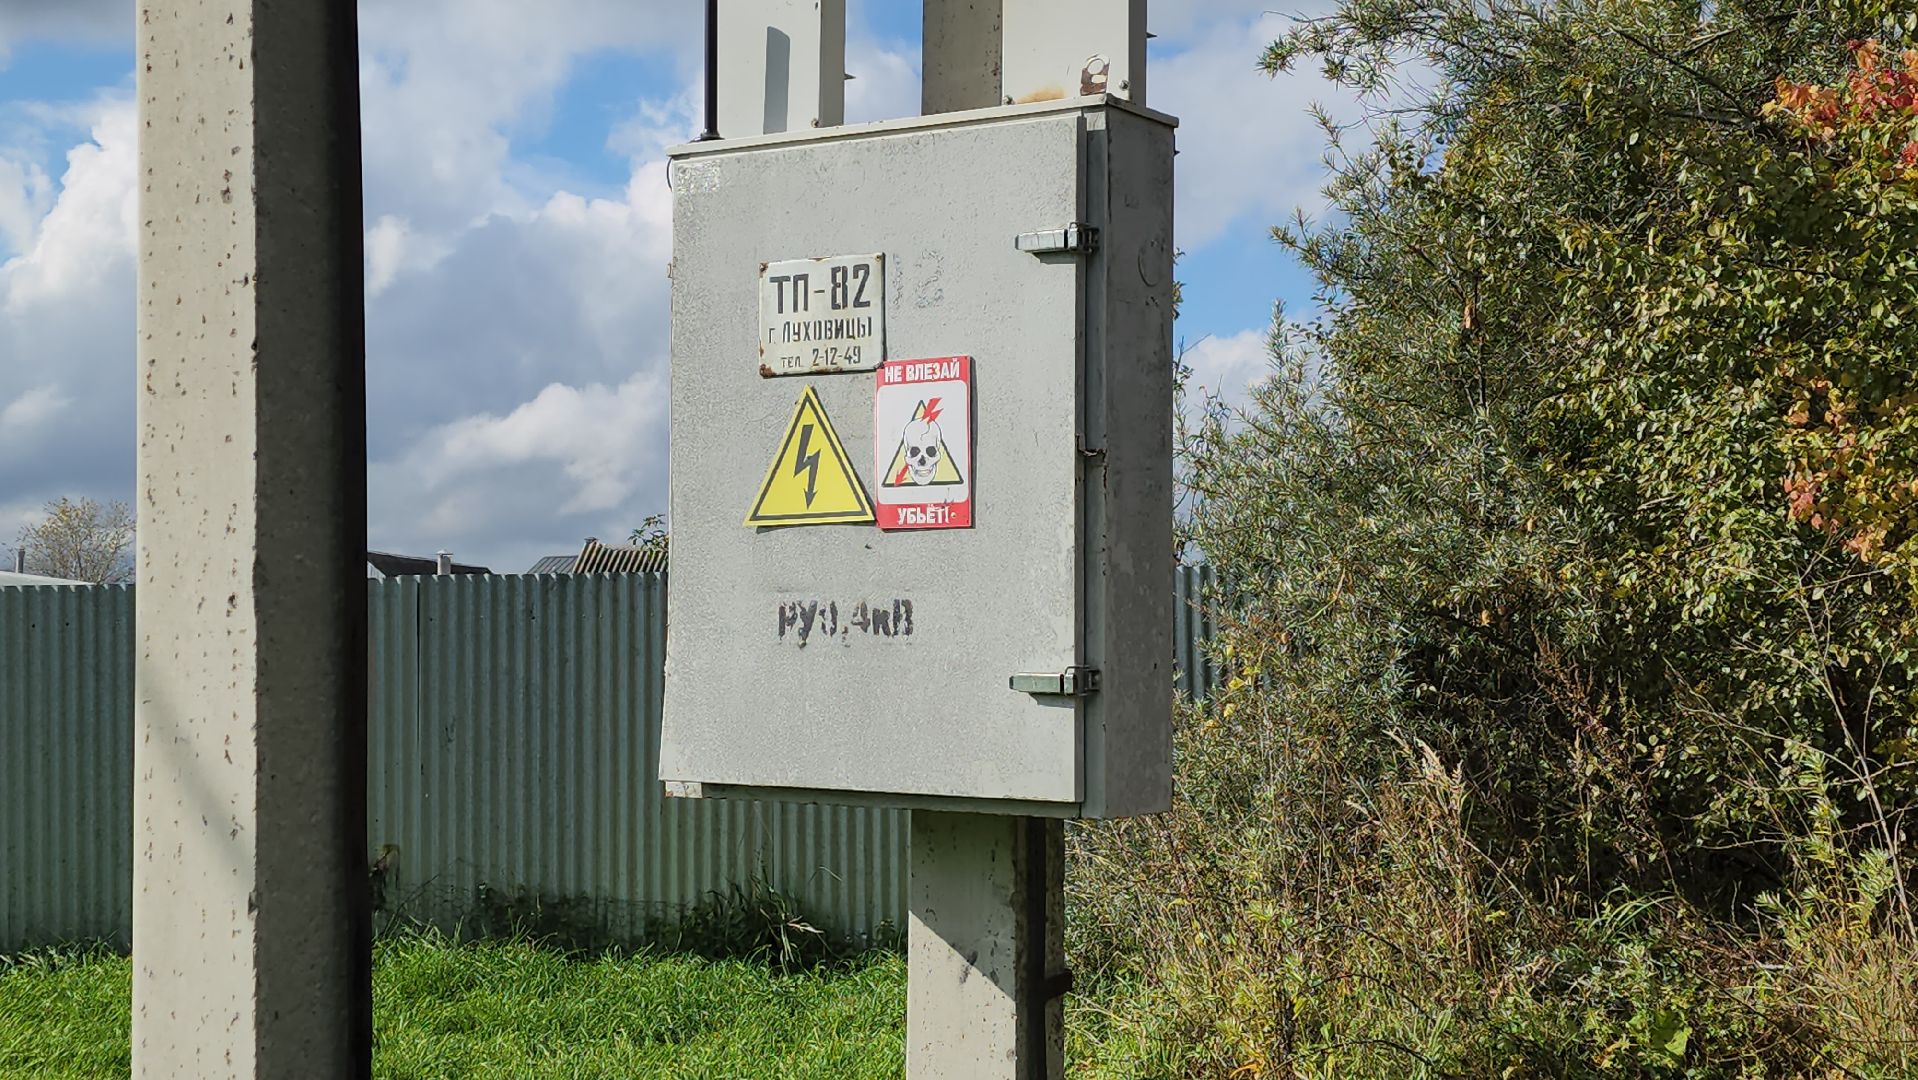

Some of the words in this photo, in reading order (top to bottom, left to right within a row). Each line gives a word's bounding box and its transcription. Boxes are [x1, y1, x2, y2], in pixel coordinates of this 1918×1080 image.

[769, 264, 871, 314] ТП-82
[782, 316, 872, 343] ЛУХОВИЦЫ
[812, 345, 861, 366] 2-12-49
[884, 365, 903, 383] НЕ
[906, 358, 960, 381] ВЛЕЗАЙ
